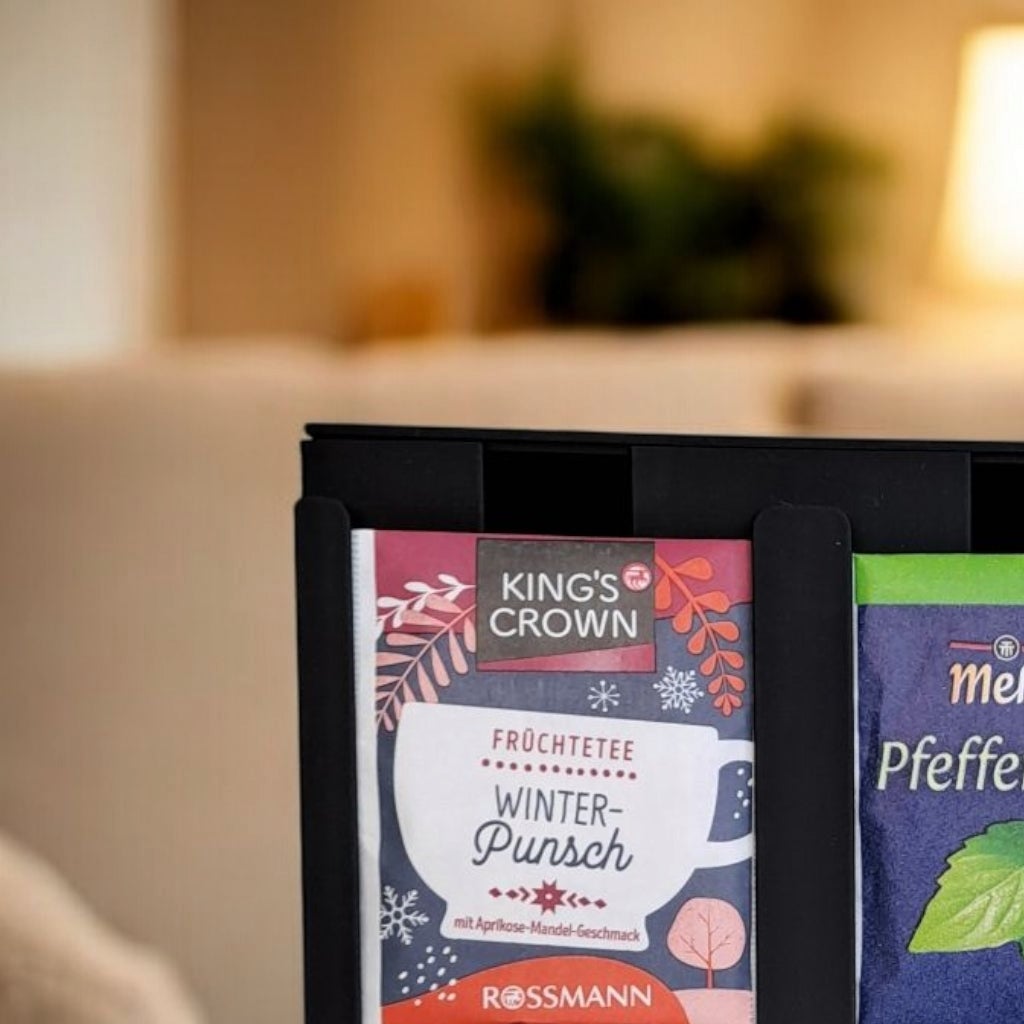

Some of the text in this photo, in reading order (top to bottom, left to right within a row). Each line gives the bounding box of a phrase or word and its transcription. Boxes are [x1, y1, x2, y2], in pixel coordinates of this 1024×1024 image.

[502, 569, 619, 602] KING'S
[489, 607, 638, 639] CROWN
[492, 728, 635, 761] FRÜCHTETEE
[495, 784, 623, 828] WINTER-
[472, 820, 634, 872] Punsch
[454, 916, 641, 943] mit Aprikose-Mandel-Geschmack
[482, 985, 652, 1010] ROSSMANN
